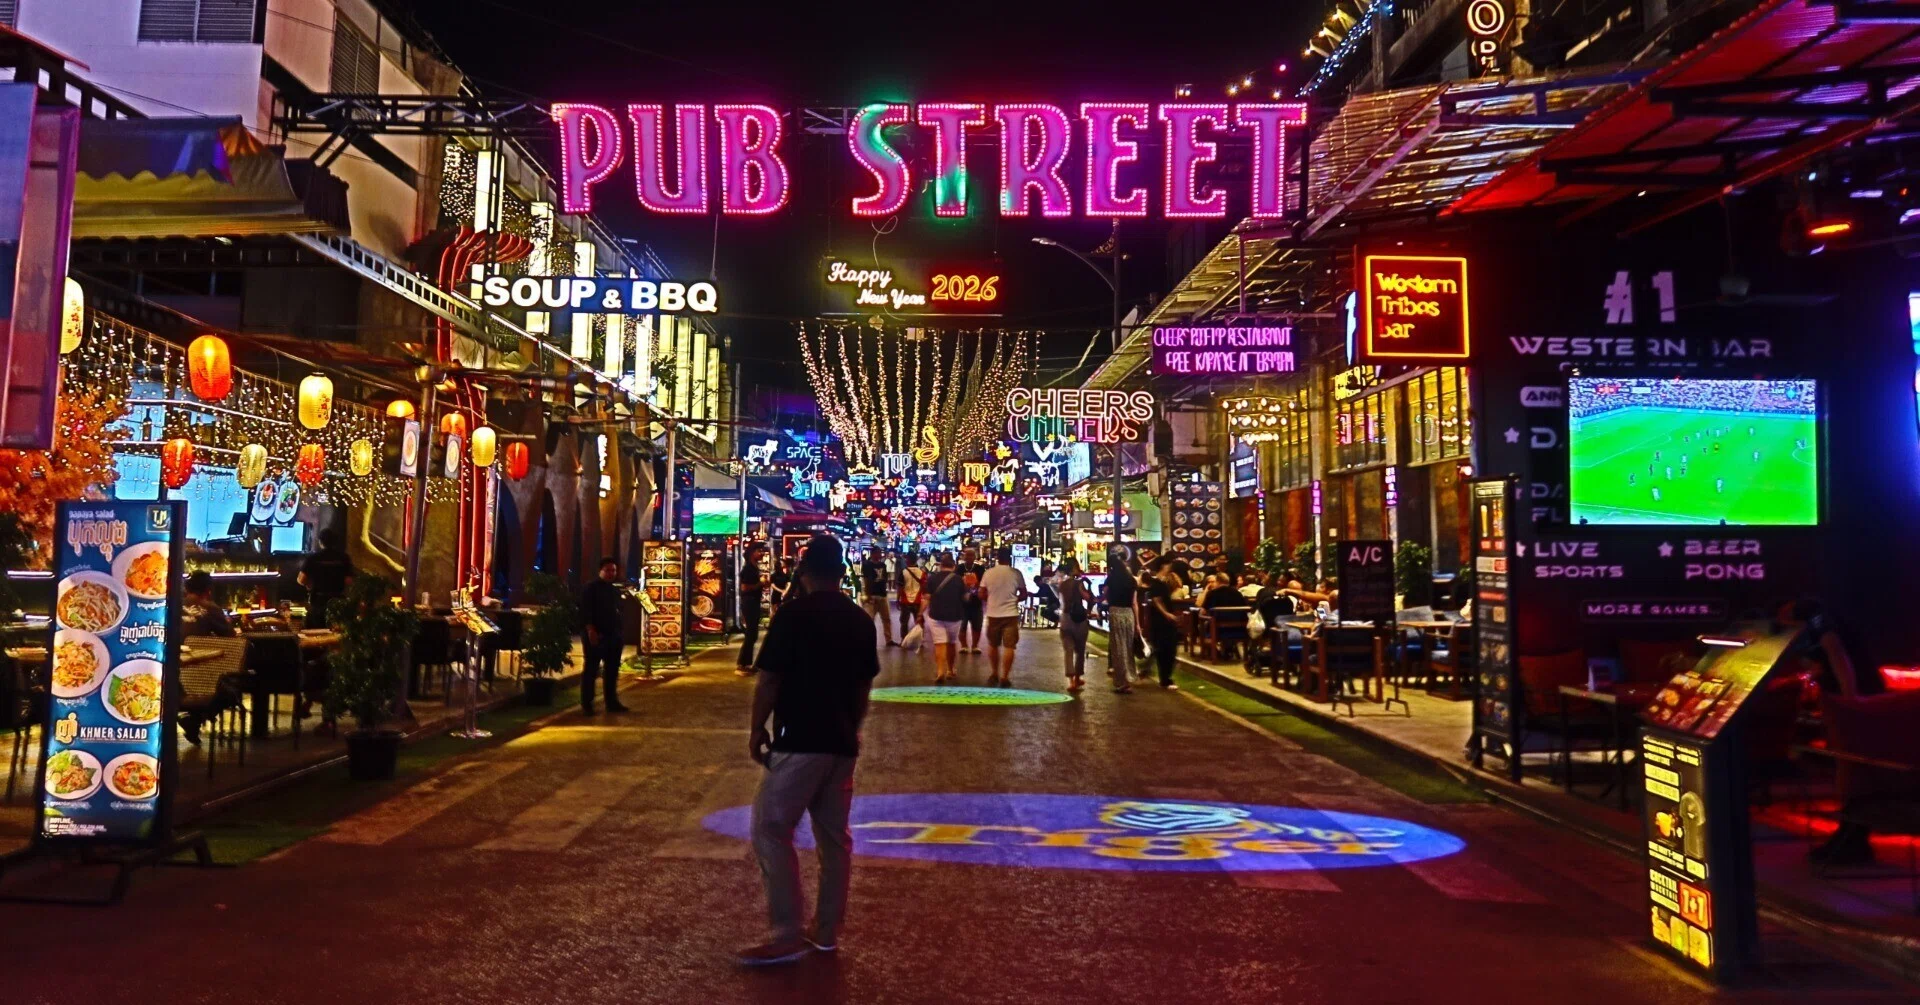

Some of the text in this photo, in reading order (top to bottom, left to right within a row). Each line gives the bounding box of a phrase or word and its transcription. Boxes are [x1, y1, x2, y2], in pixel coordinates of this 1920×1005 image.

[551, 101, 1309, 218] PUB STREET
[827, 261, 893, 288] Happy
[484, 277, 718, 313] SOUP & BBQ
[856, 288, 926, 310] New Year
[931, 274, 999, 302] 2026
[1006, 387, 1154, 422] CHEERS
[786, 446, 822, 458] SPACE
[881, 453, 913, 479] TOP
[963, 463, 991, 487] TOP
[1348, 546, 1382, 566] A/C
[1534, 541, 1599, 558] LIVE
[1684, 539, 1761, 555] BEER
[1535, 565, 1624, 578] SPORTS
[1685, 563, 1765, 580] PONG
[1587, 604, 1643, 615] MORE
[80, 727, 148, 740] KHMER SALAD
[850, 820, 1402, 861] Tiger
